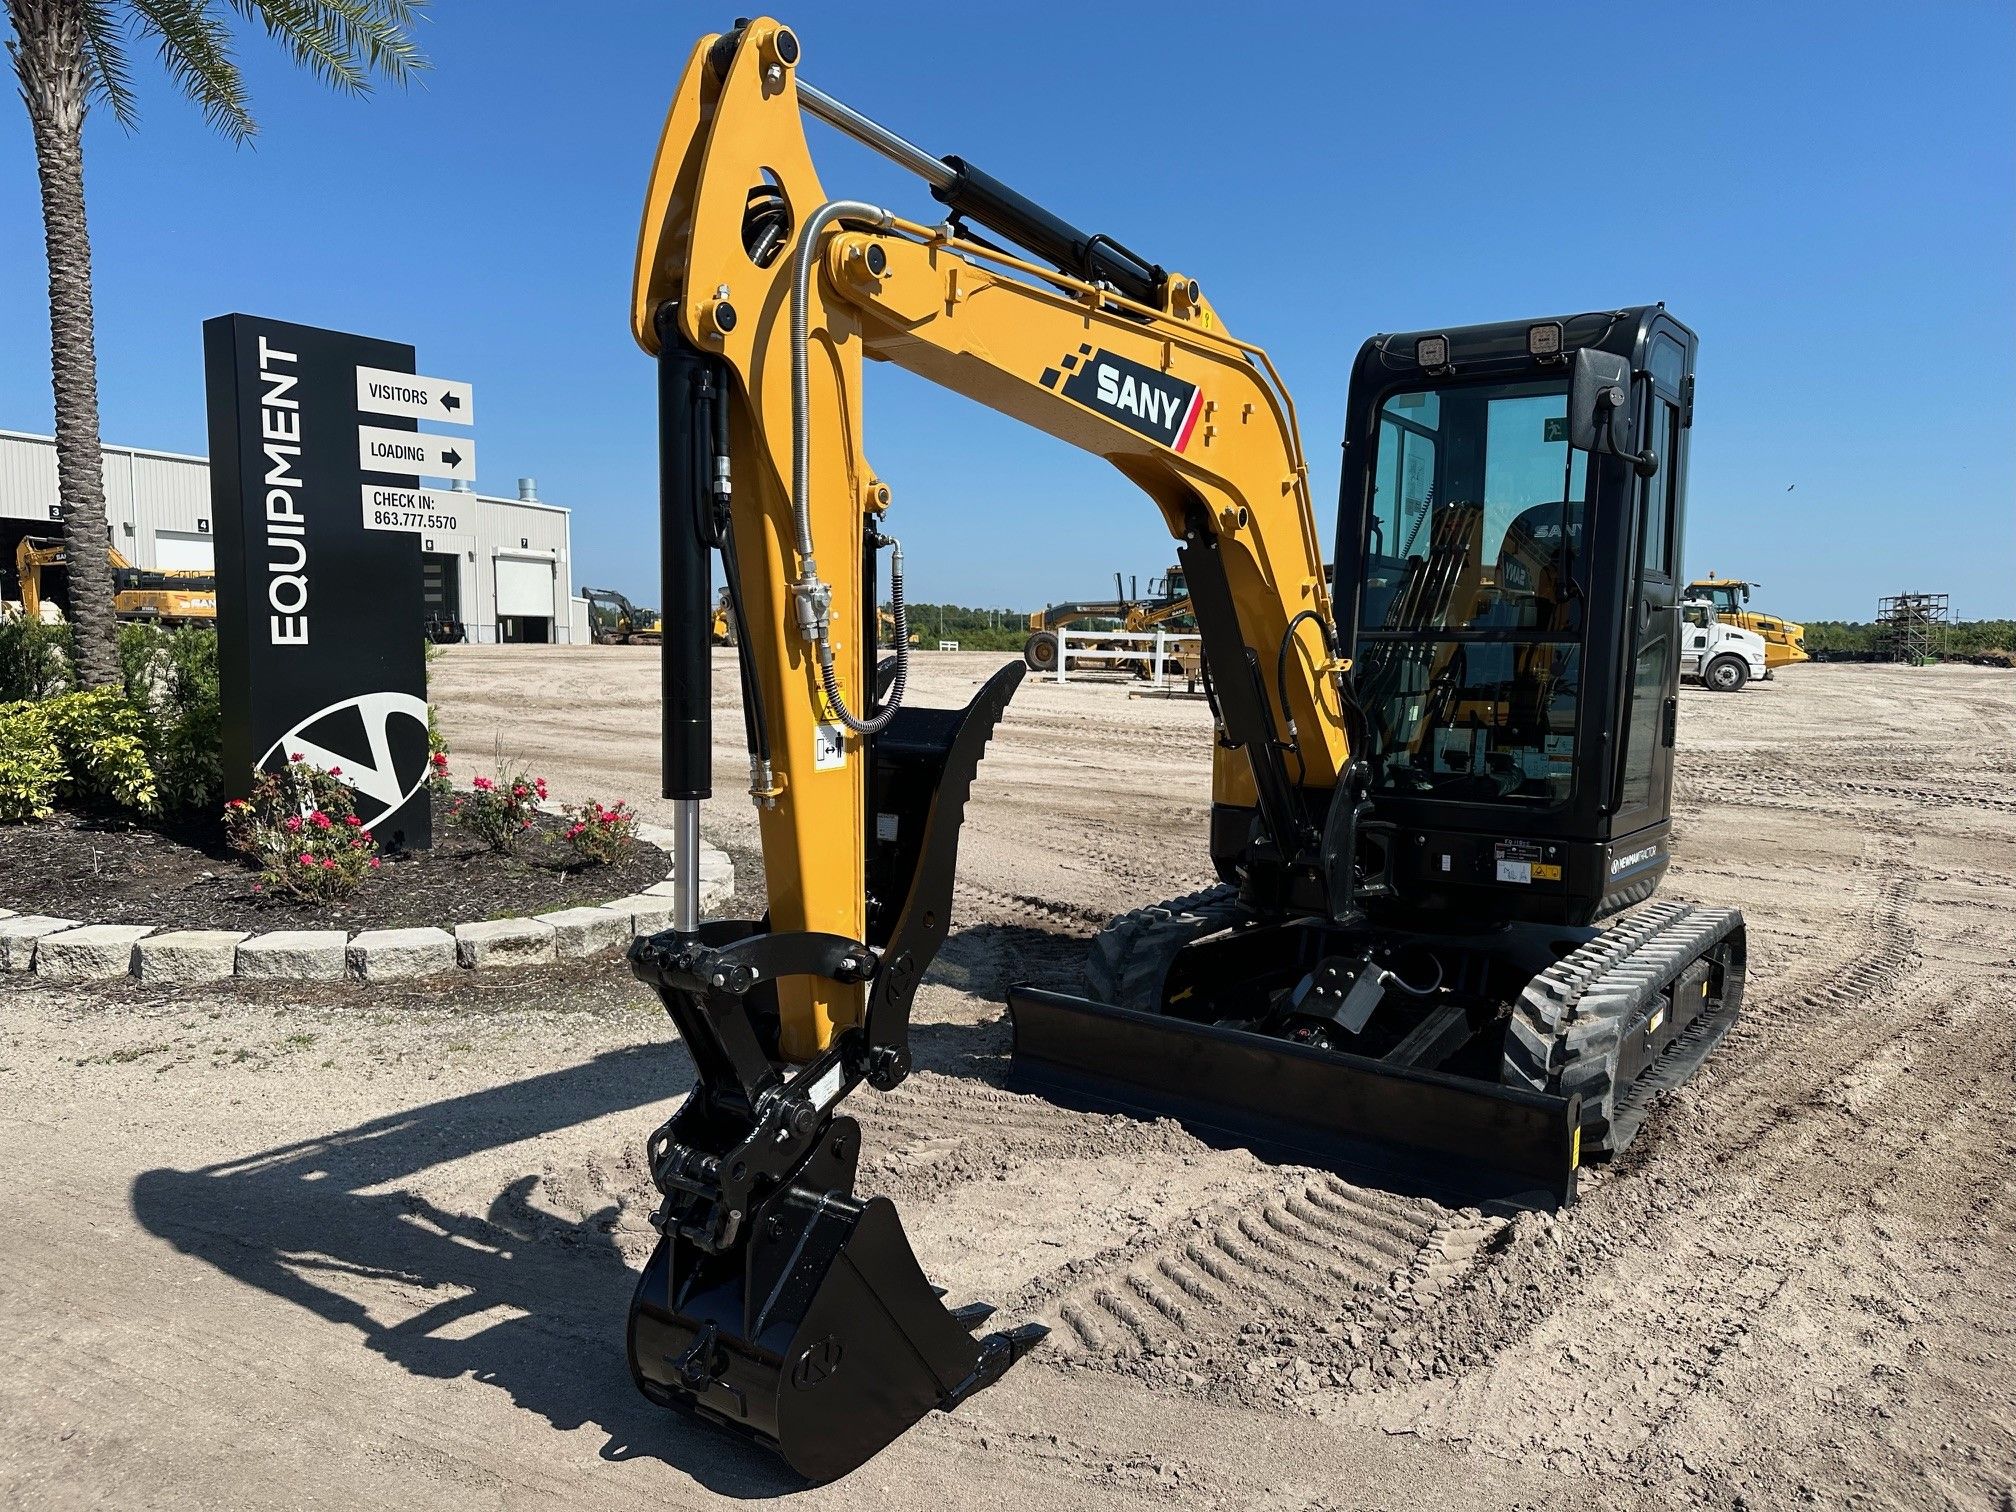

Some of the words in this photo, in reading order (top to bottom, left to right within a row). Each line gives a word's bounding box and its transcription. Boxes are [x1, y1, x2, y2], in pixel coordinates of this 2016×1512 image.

[369, 382, 428, 405] VISITORS
[1096, 363, 1181, 430] SANY
[370, 442, 425, 462] LOADING
[258, 335, 309, 645] EQUIPMENT
[373, 491, 416, 508] CHECK
[418, 495, 435, 510] IN:
[52, 507, 60, 516] 3
[374, 511, 457, 530] 863.777.5570
[200, 520, 207, 529] 4
